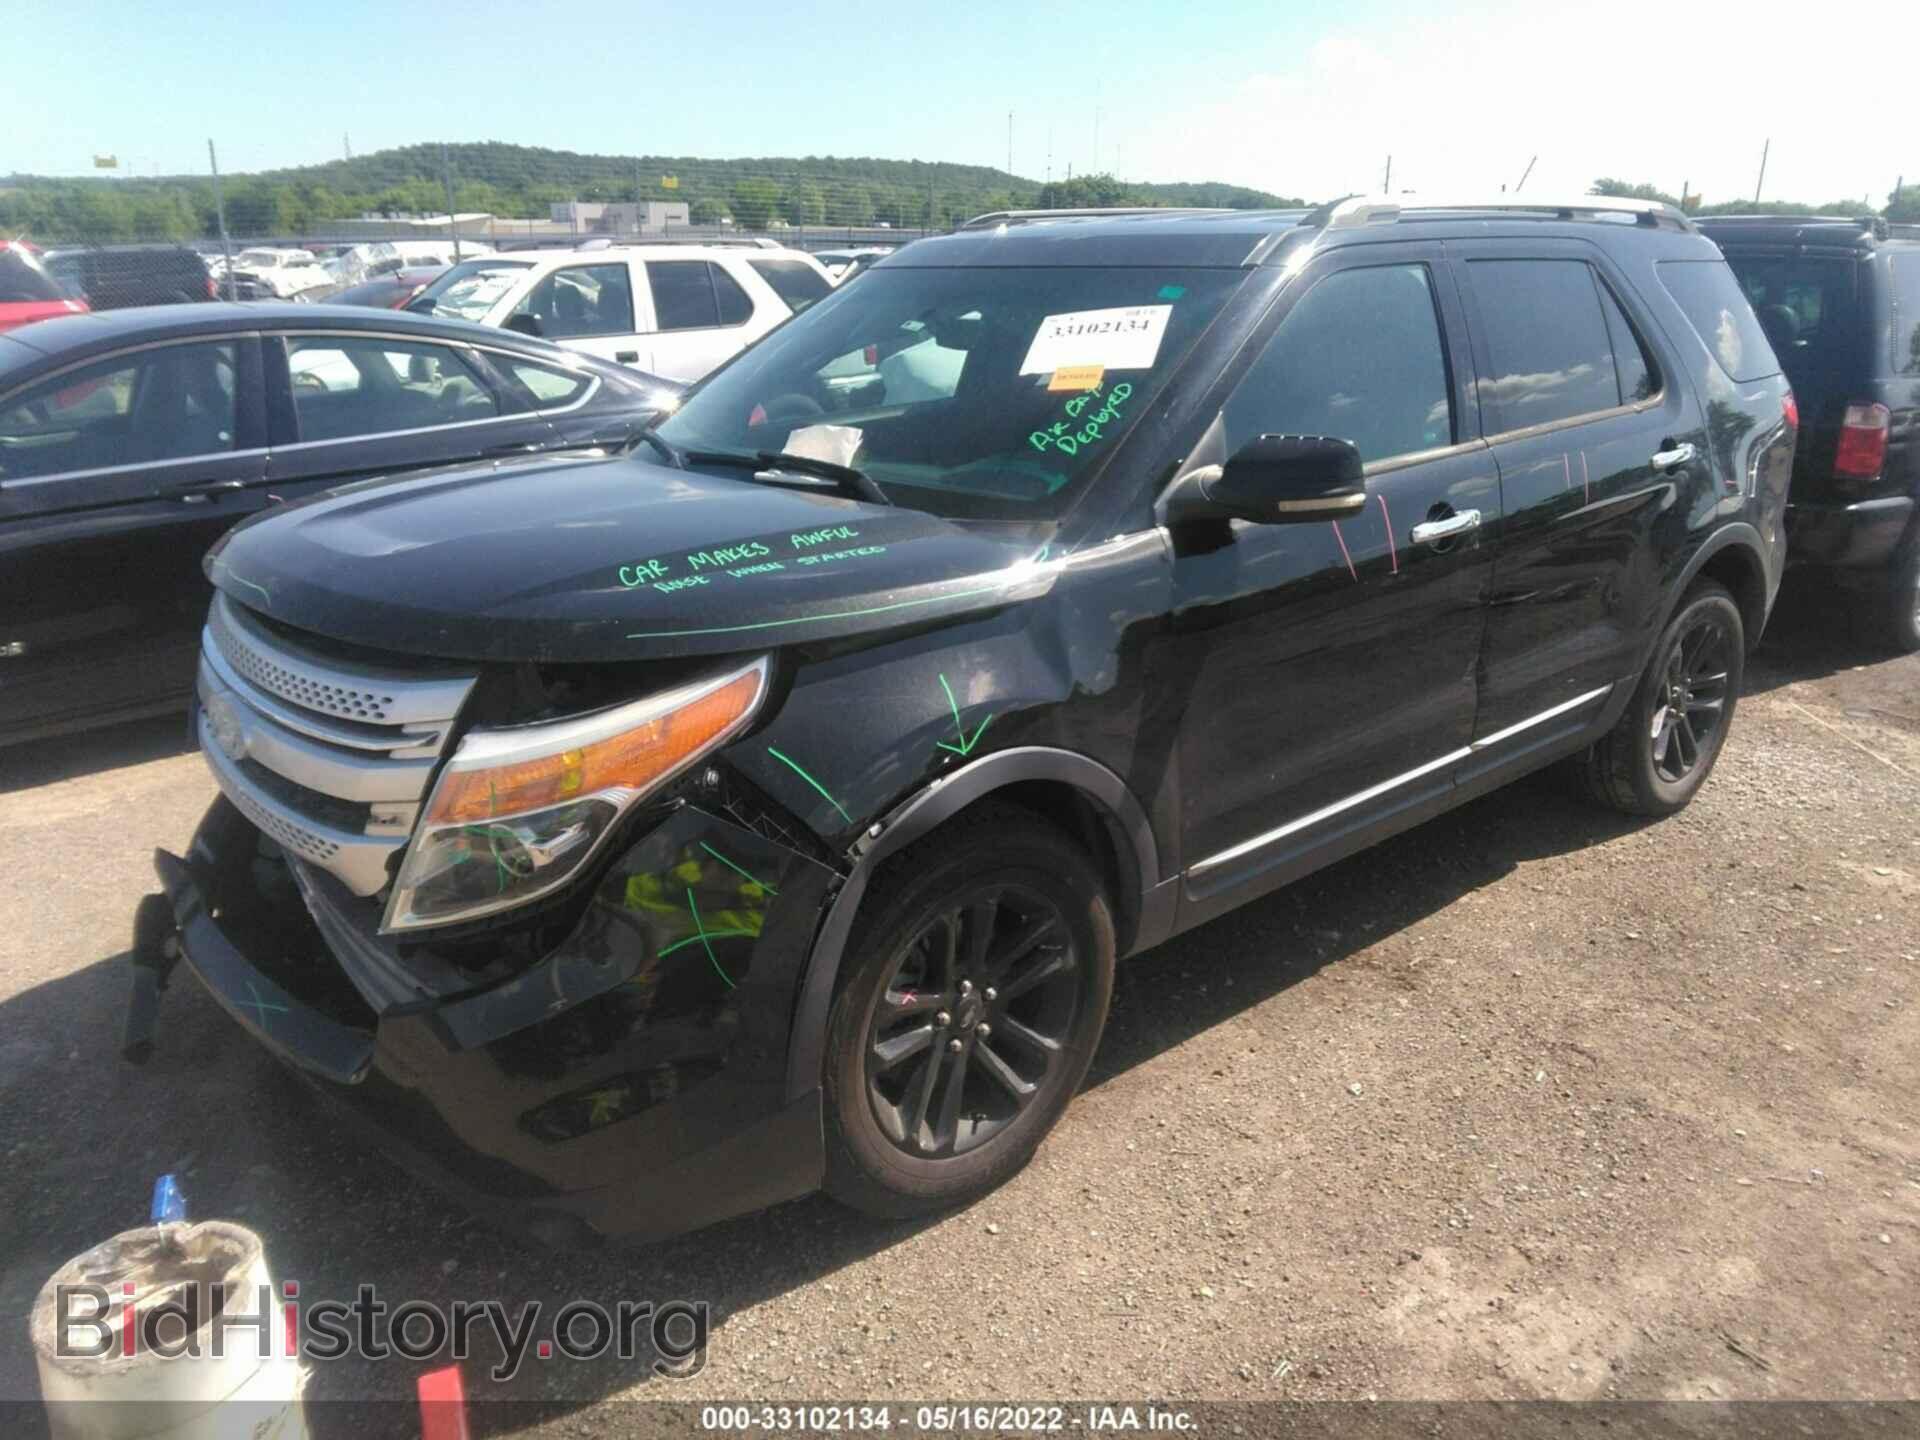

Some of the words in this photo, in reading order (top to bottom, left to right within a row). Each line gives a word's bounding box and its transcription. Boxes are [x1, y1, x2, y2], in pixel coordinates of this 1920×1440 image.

[1049, 318, 1150, 338] 33102134
[618, 558, 669, 587] CAR
[688, 542, 769, 570] MAKES
[791, 525, 859, 550] AWFUL
